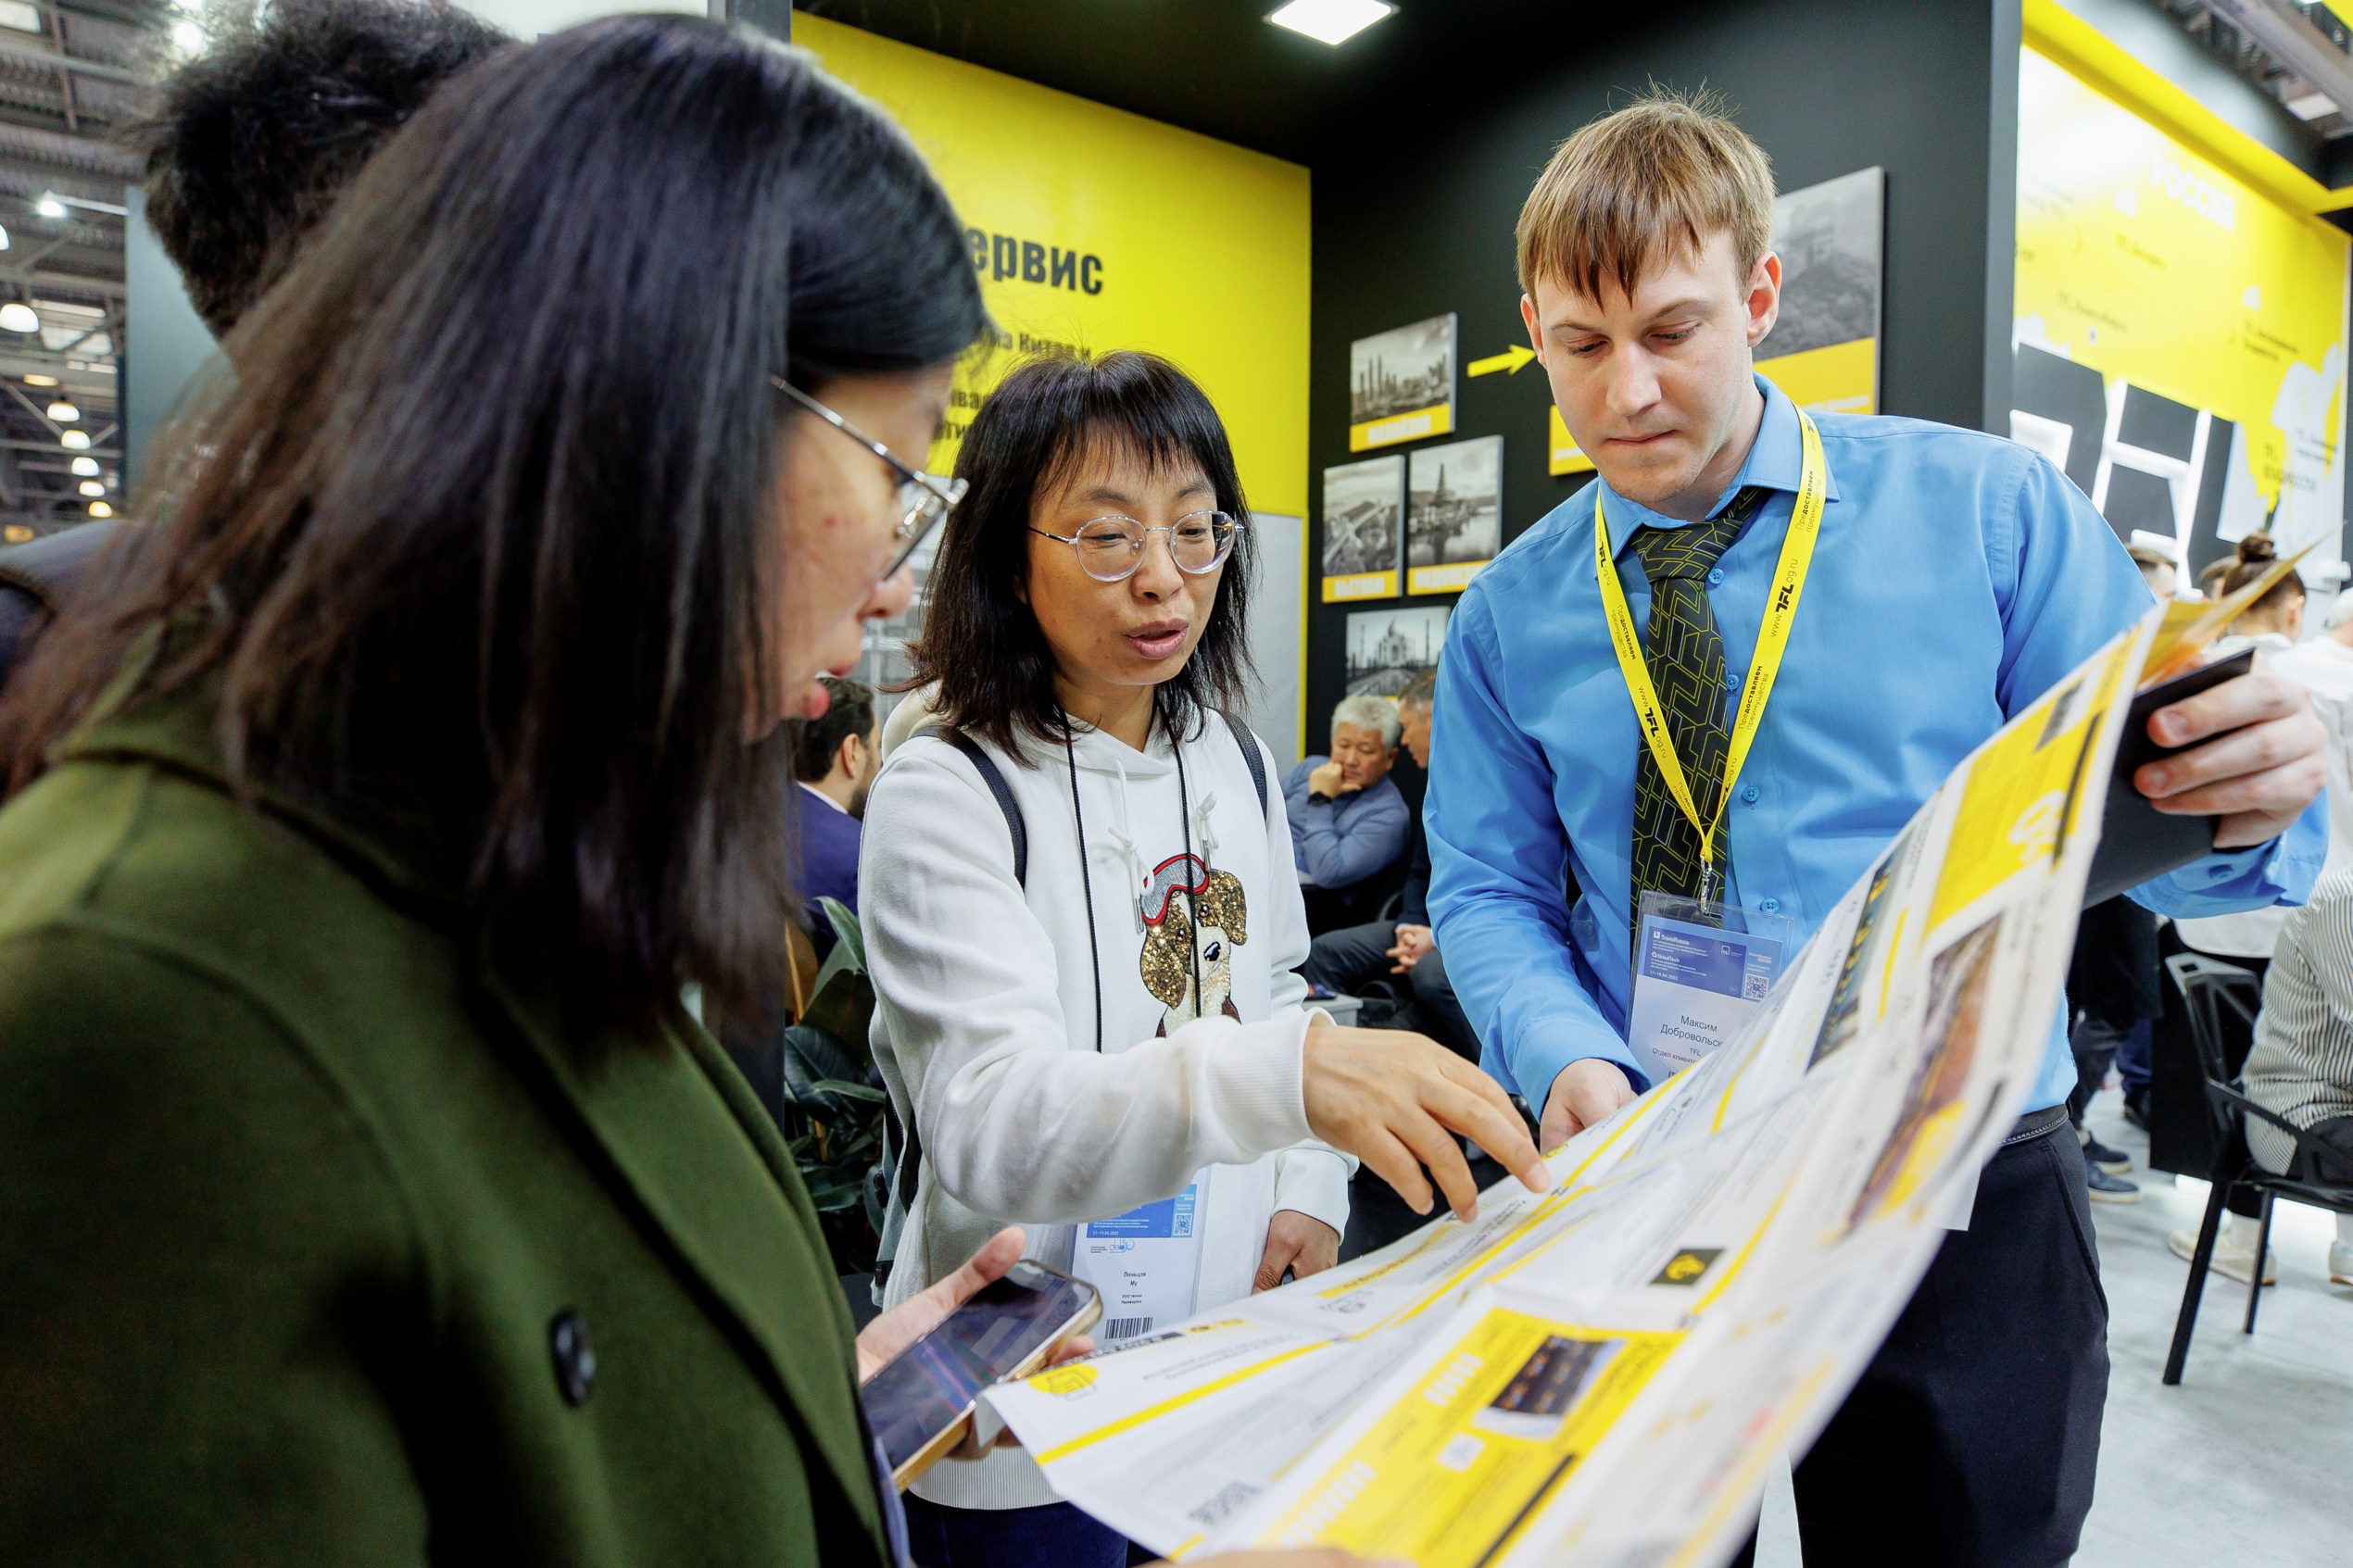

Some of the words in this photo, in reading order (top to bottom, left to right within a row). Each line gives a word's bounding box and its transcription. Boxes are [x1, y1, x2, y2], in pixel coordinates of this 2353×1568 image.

[964, 227, 1103, 296] ервис
[1617, 604, 1636, 660] Предоставляем
[1739, 666, 1763, 730] Предоставляем
[1747, 673, 1769, 730] преимущества
[1680, 1015, 1718, 1033] Максим
[1689, 1047, 1702, 1057] TFL
[1652, 1047, 1672, 1059] Отдел
